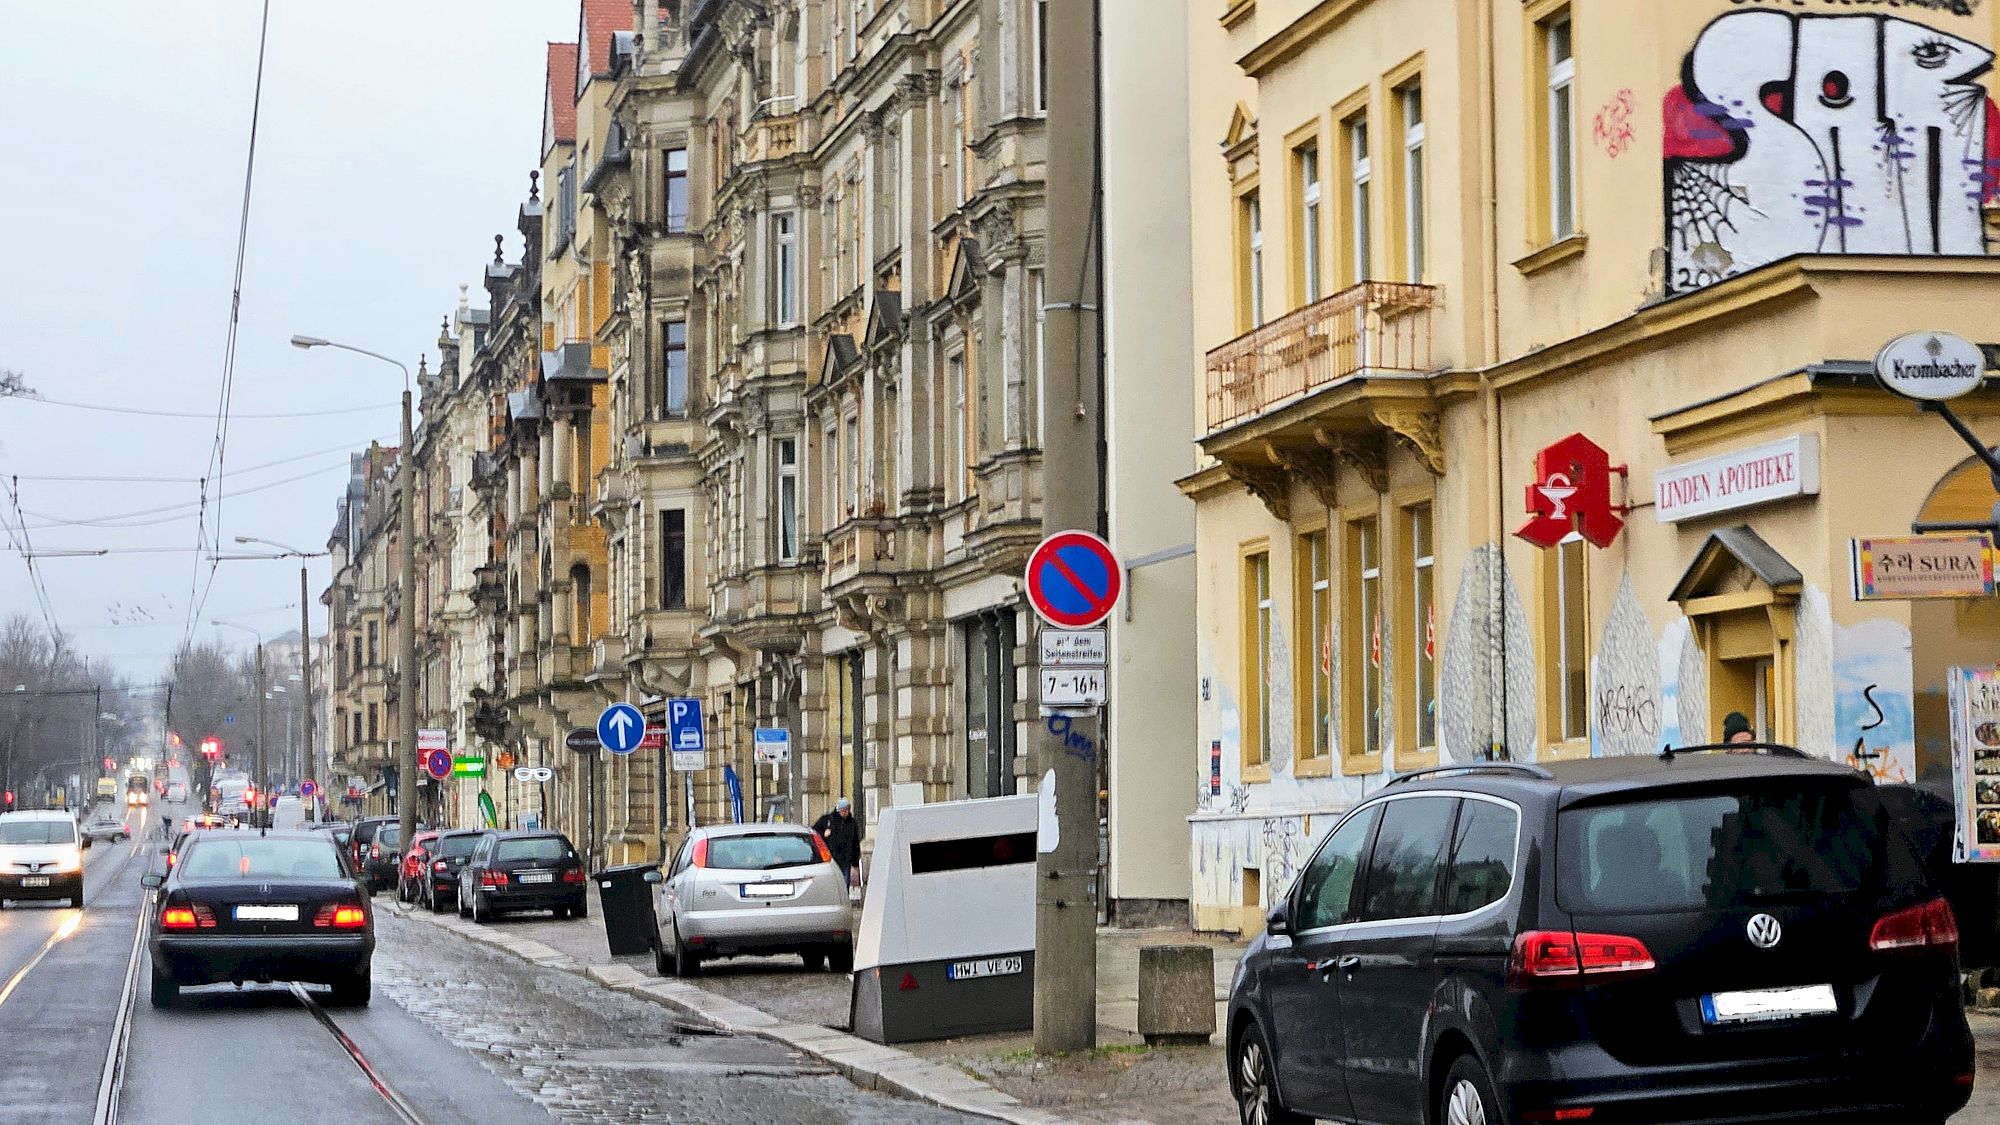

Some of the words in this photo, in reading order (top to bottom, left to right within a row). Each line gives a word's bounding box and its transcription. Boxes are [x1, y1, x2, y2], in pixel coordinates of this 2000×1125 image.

[1893, 356, 1976, 378] Krombacher
[1660, 471, 1711, 509] LINDEN
[1718, 451, 1796, 497] APOTHEKE
[1920, 555, 1976, 573] SURA
[673, 703, 688, 725] P
